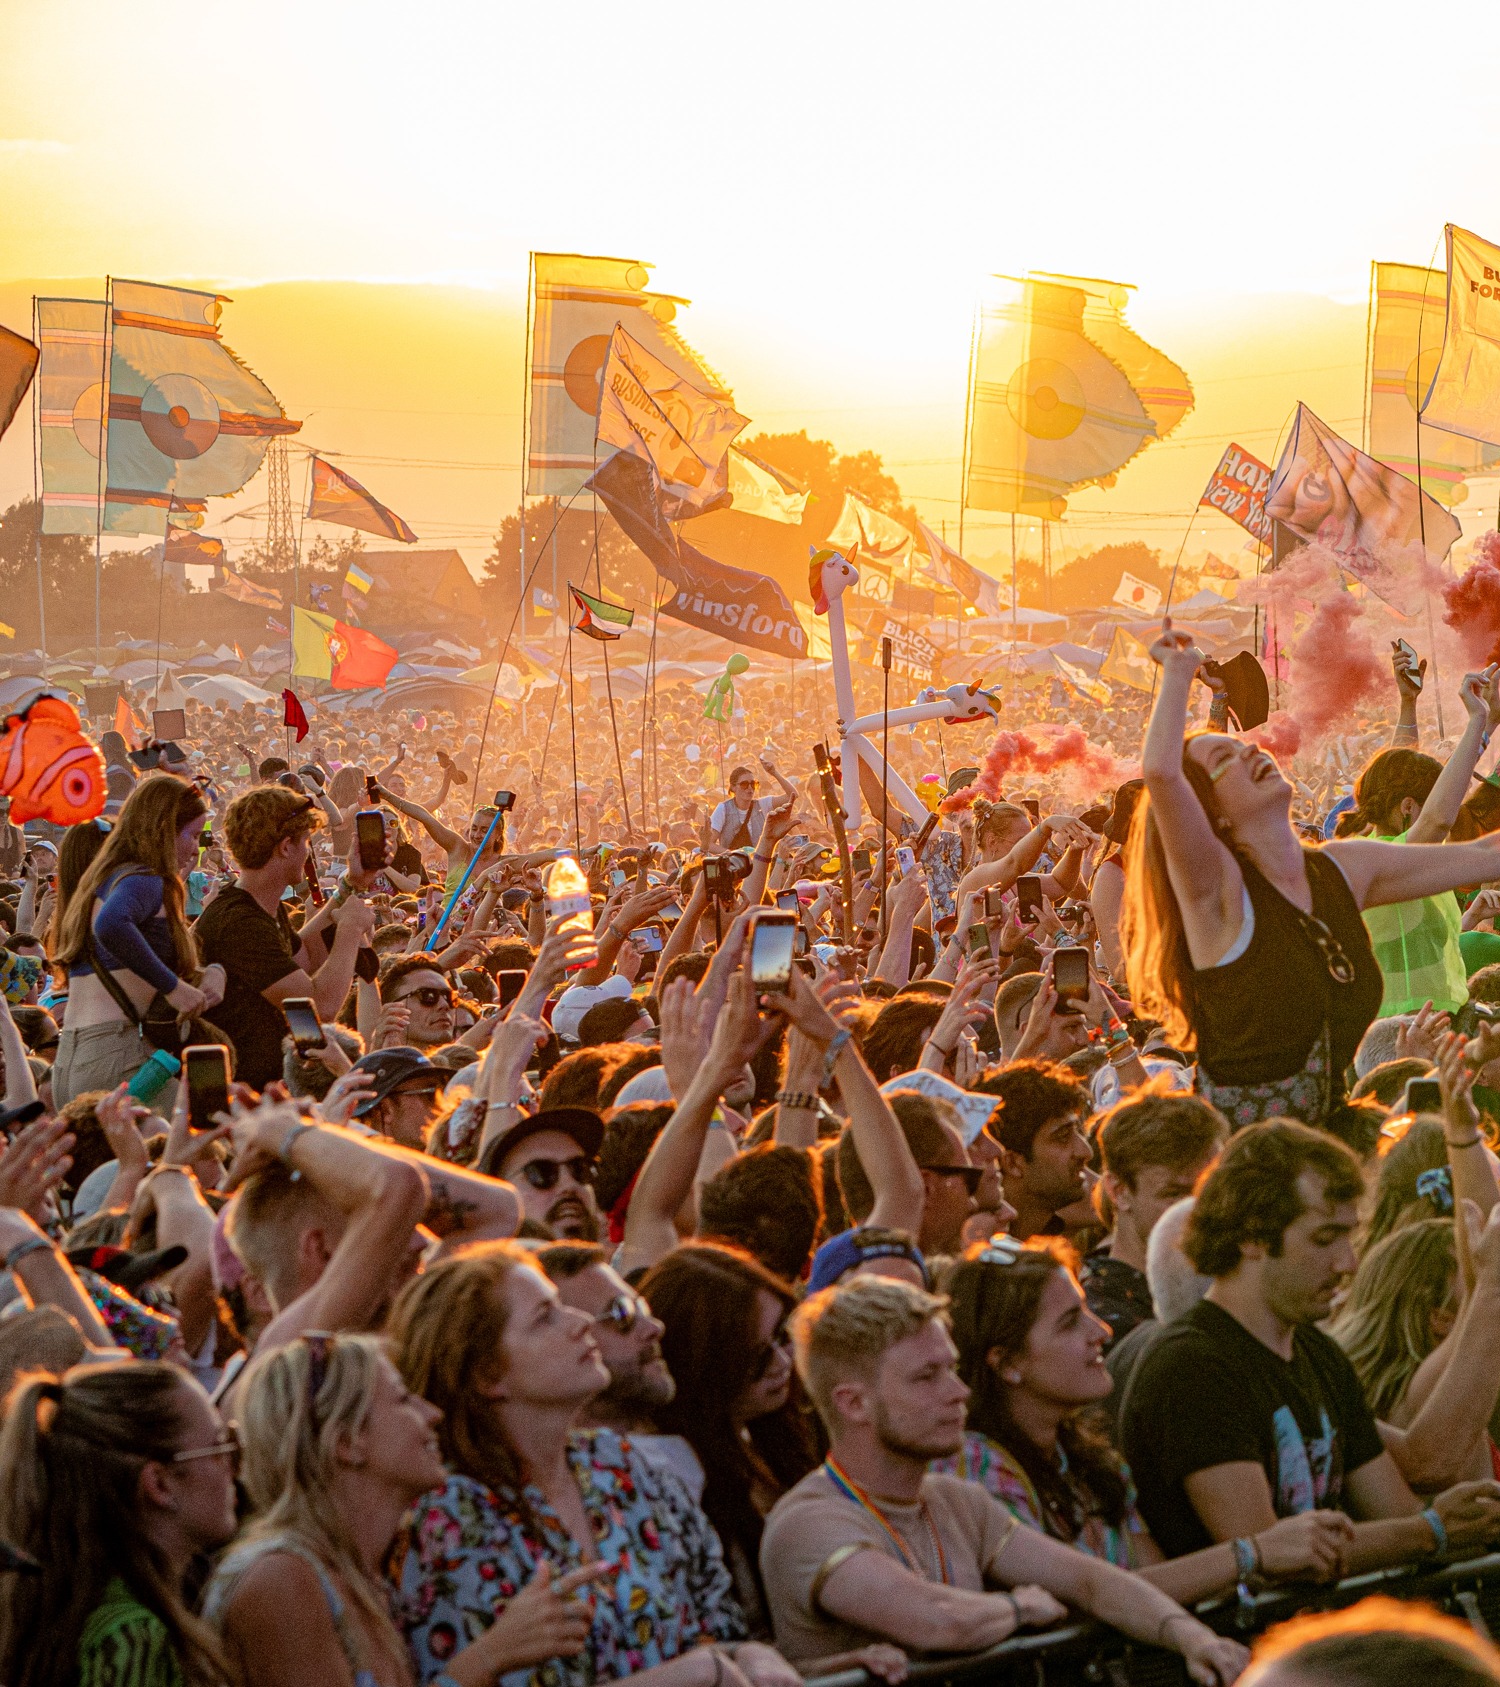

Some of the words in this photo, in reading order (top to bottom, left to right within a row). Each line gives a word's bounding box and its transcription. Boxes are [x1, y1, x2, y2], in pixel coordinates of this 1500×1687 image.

[1217, 447, 1271, 494] Hap
[1241, 495, 1272, 540] Yea
[877, 633, 933, 669] LVES
[884, 620, 939, 656] BLACK
